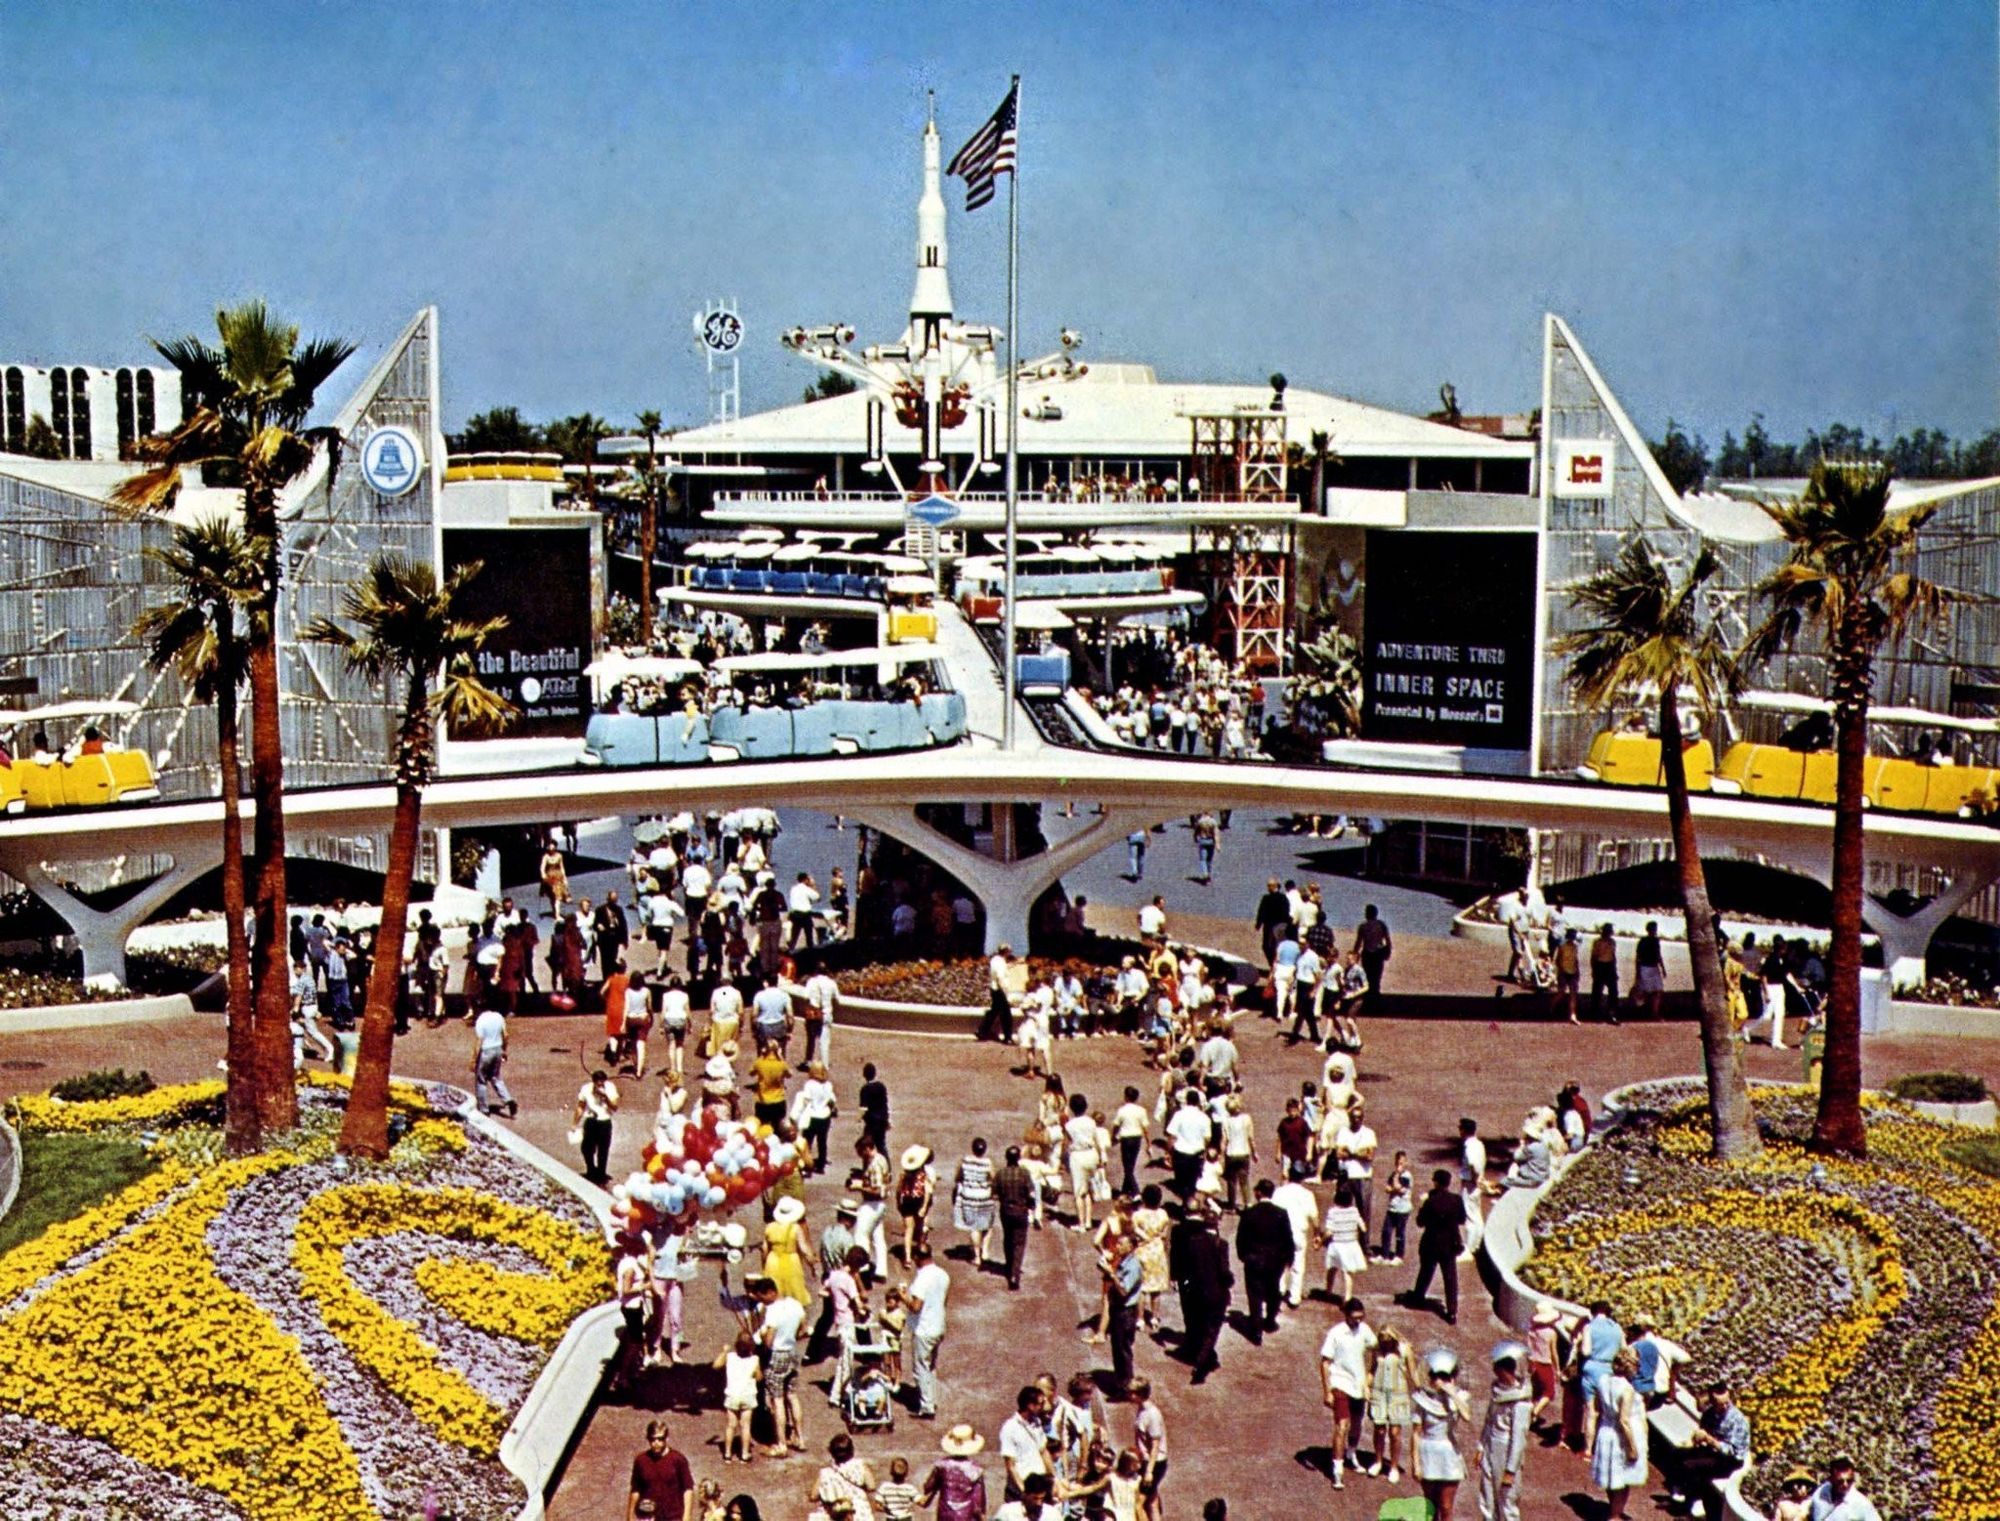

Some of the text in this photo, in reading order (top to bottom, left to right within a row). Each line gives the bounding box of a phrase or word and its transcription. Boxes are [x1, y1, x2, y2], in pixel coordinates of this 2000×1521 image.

[479, 647, 580, 674] the Beautiful
[1377, 643, 1505, 664] ADVENTURE THRU
[1376, 673, 1505, 699] INNER SPACE
[1375, 703, 1422, 718] Presented
[1425, 706, 1436, 722] by
